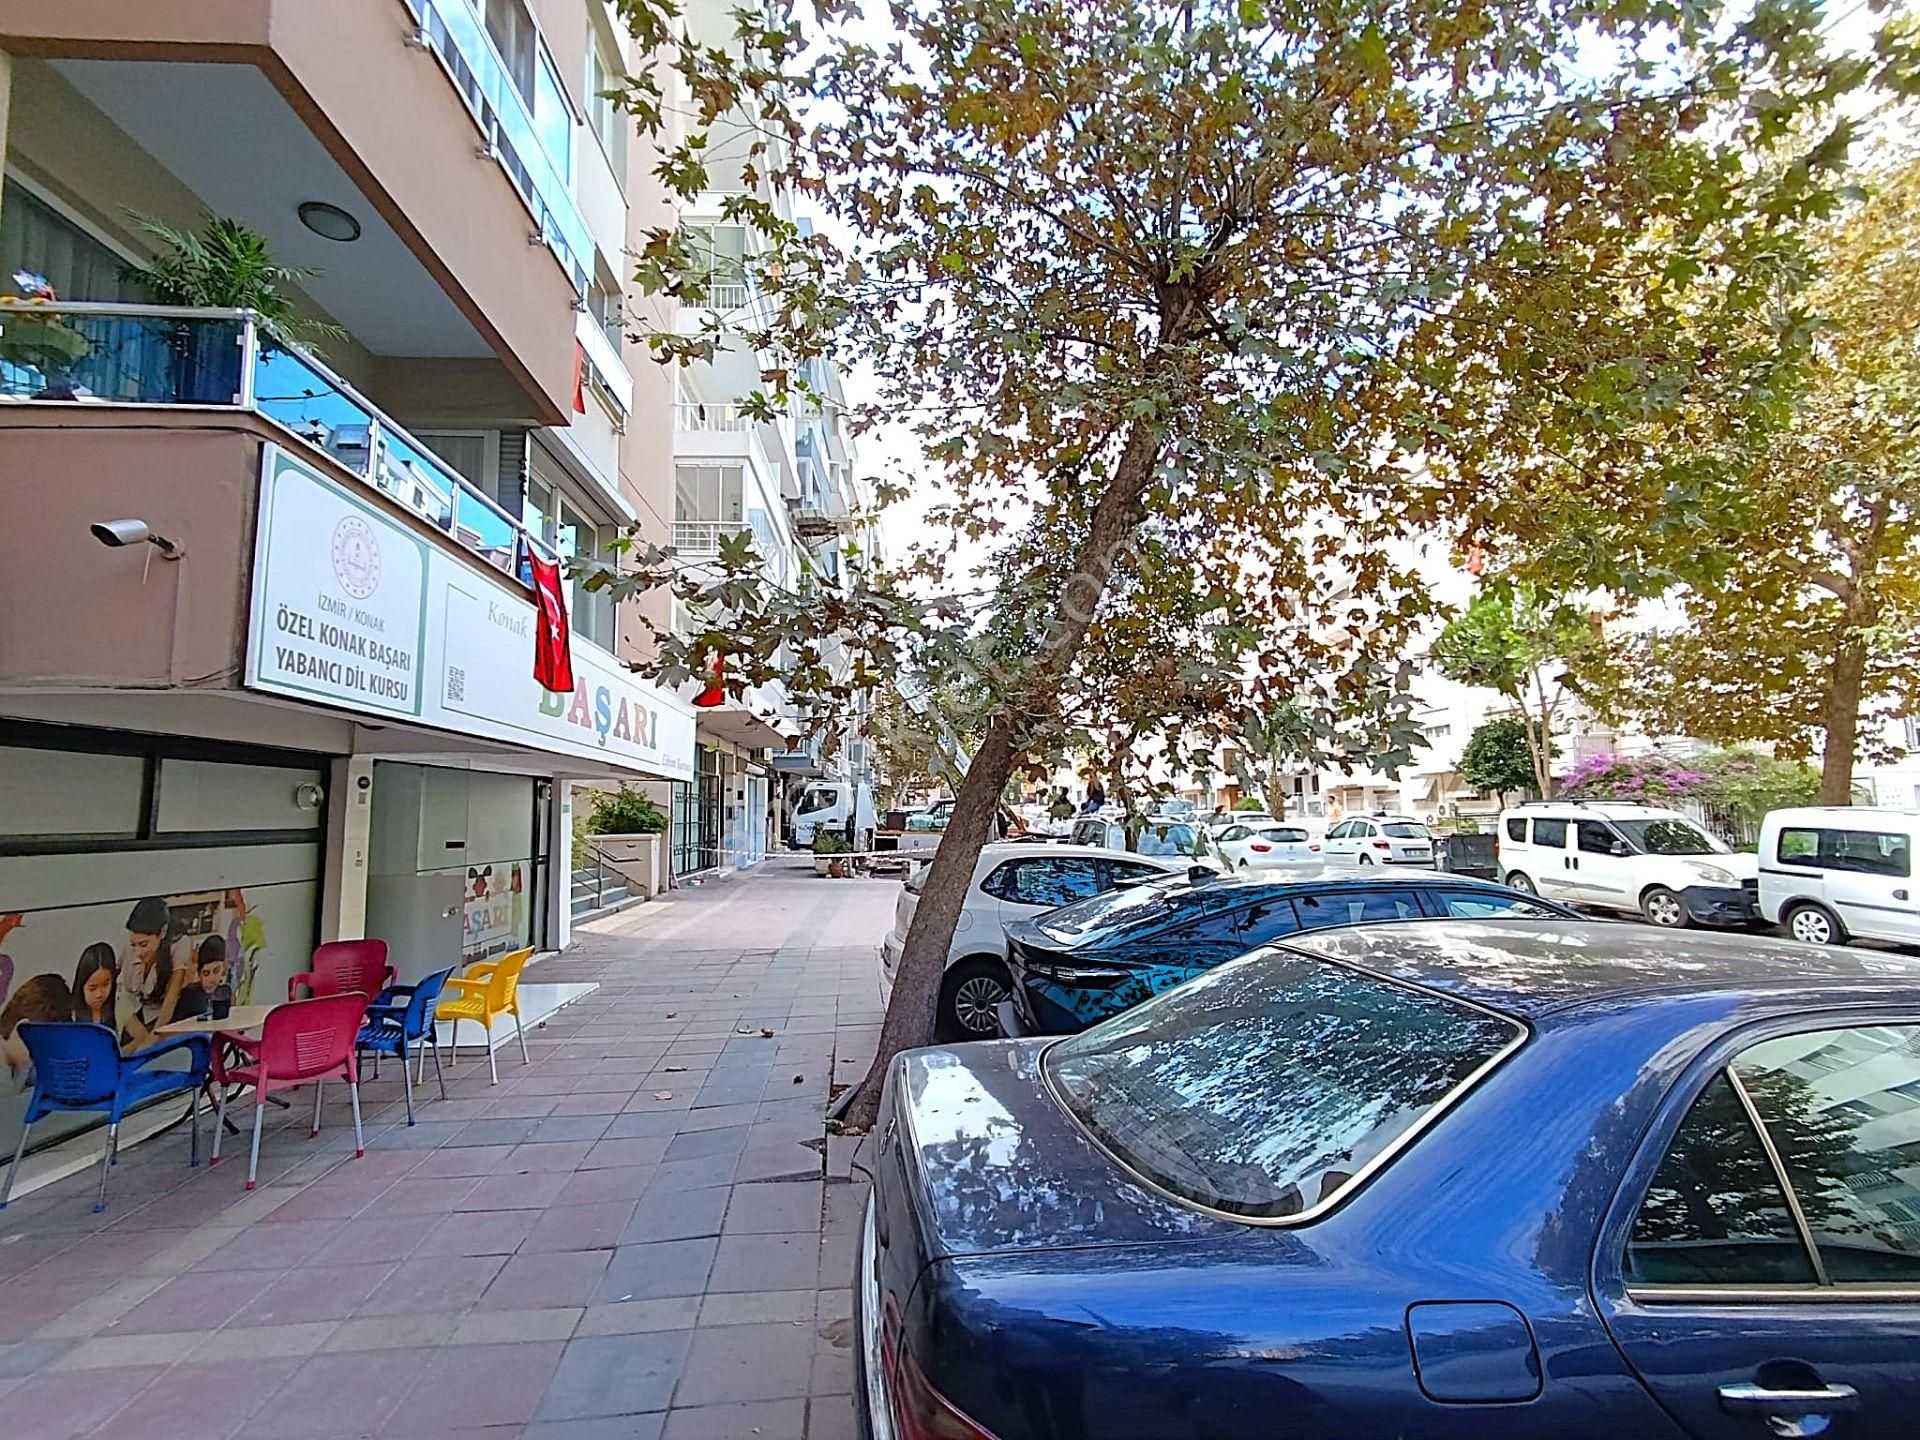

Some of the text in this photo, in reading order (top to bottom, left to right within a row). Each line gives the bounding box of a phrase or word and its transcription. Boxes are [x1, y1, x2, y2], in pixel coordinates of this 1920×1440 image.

[318, 590, 346, 620] İZMİR
[355, 609, 385, 633] KONAK
[487, 601, 529, 638] Konak
[276, 603, 411, 671] ÖZEL KONAK BAŞARI
[275, 646, 408, 701] YABANCI DİL KURSU
